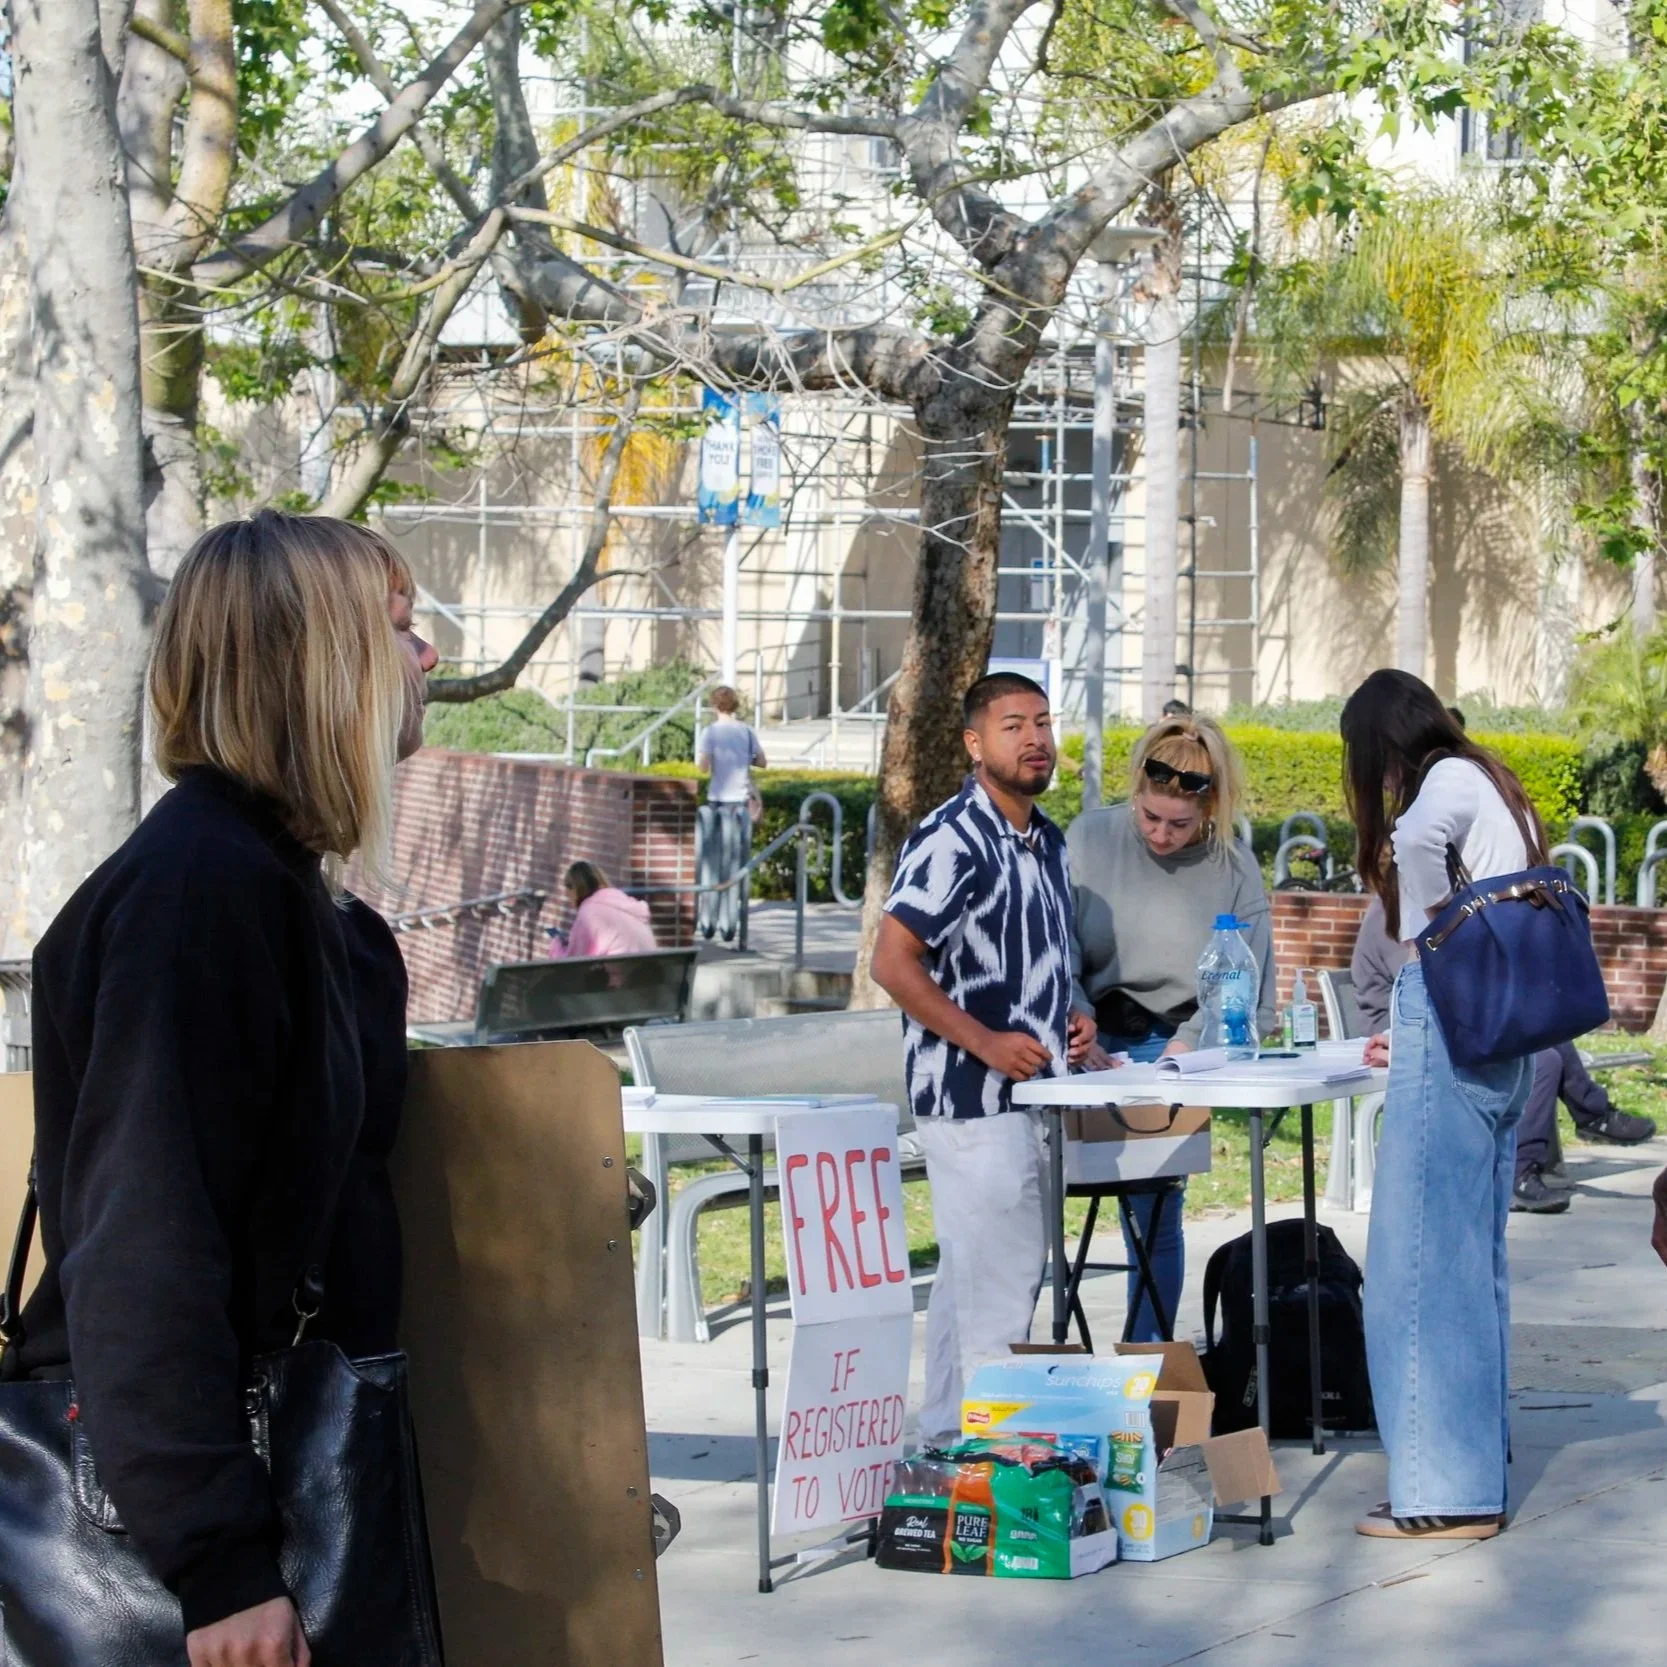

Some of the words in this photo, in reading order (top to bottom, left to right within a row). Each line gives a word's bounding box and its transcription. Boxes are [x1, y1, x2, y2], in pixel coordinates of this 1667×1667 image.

[1201, 970, 1241, 981] Eternal
[786, 1147, 905, 1296] FREE
[830, 1349, 861, 1393] IF
[784, 1394, 905, 1461] REGISTERED
[792, 1476, 820, 1519] TO
[906, 1515, 929, 1528] Real
[957, 1515, 989, 1528] PURE
[894, 1529, 923, 1539] BREWED
[924, 1529, 936, 1539] TEA
[955, 1525, 986, 1538] LEAF
